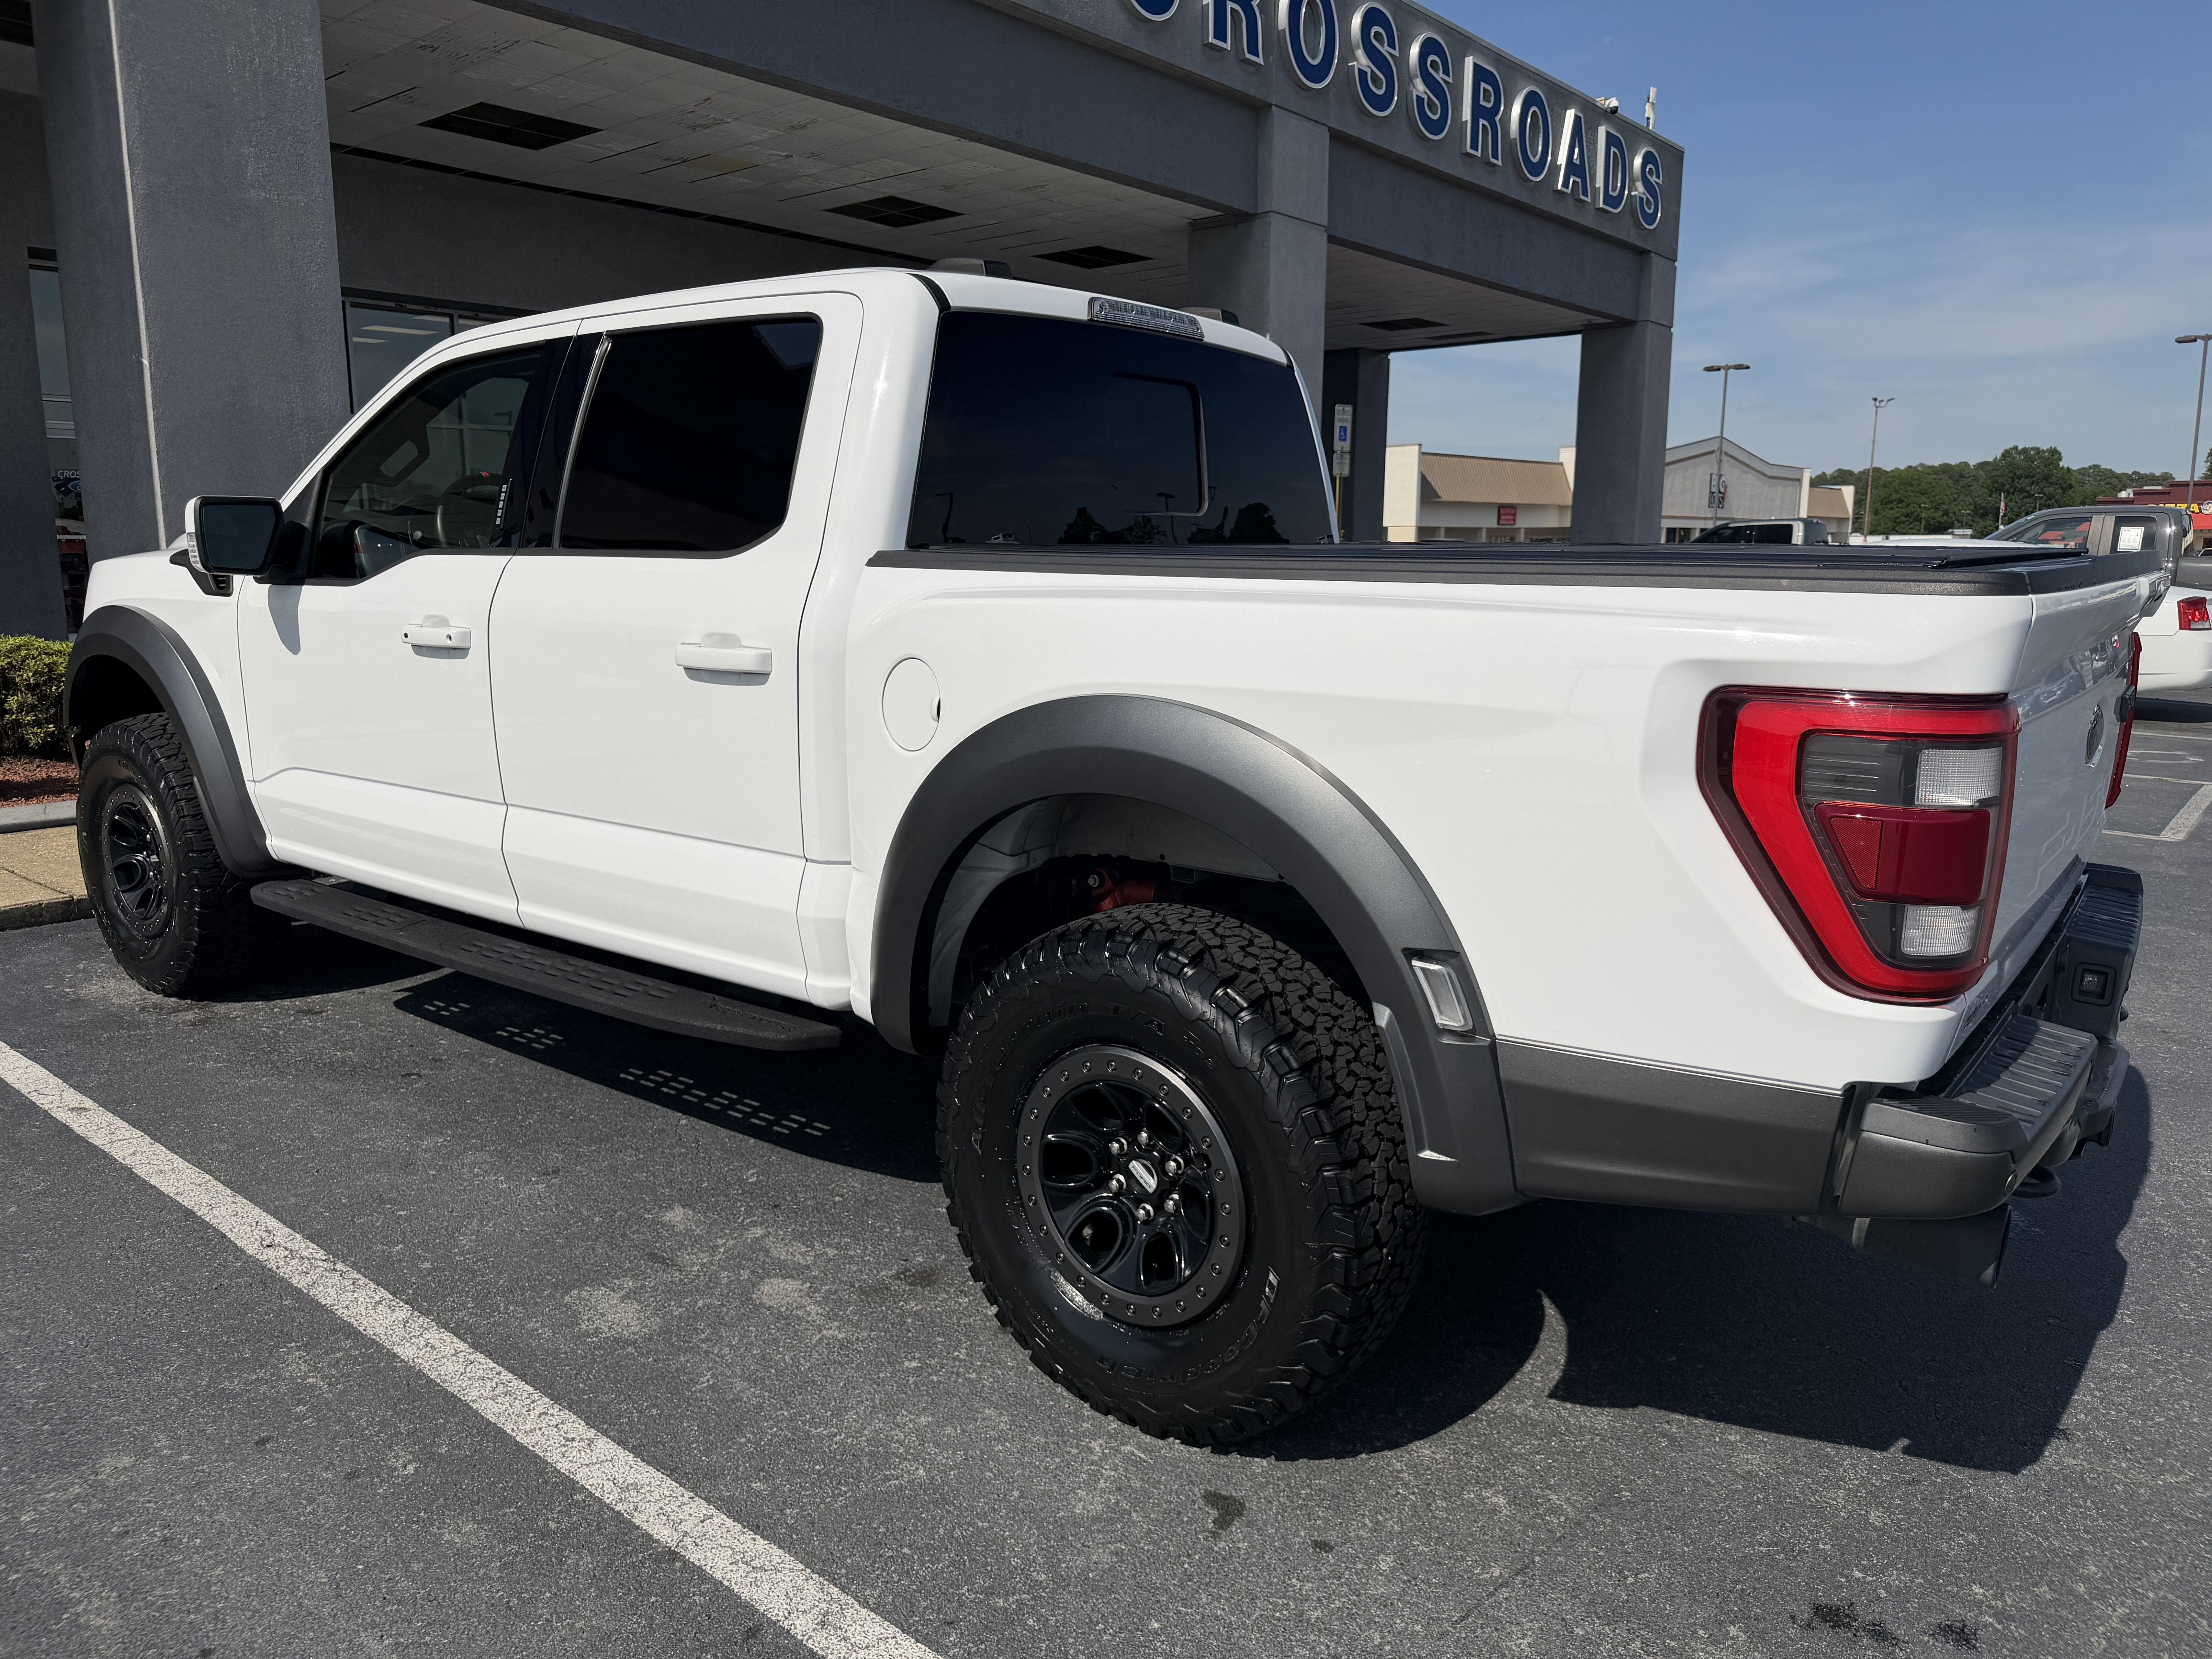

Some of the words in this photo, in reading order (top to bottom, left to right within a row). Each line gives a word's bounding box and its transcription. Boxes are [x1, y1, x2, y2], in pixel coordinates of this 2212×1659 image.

[1125, 0, 1662, 229] OSSROADS
[1710, 473, 1727, 493] BG
[1132, 1165, 1151, 1188] FORD
[1096, 1265, 1281, 1386] BFGoodrich
